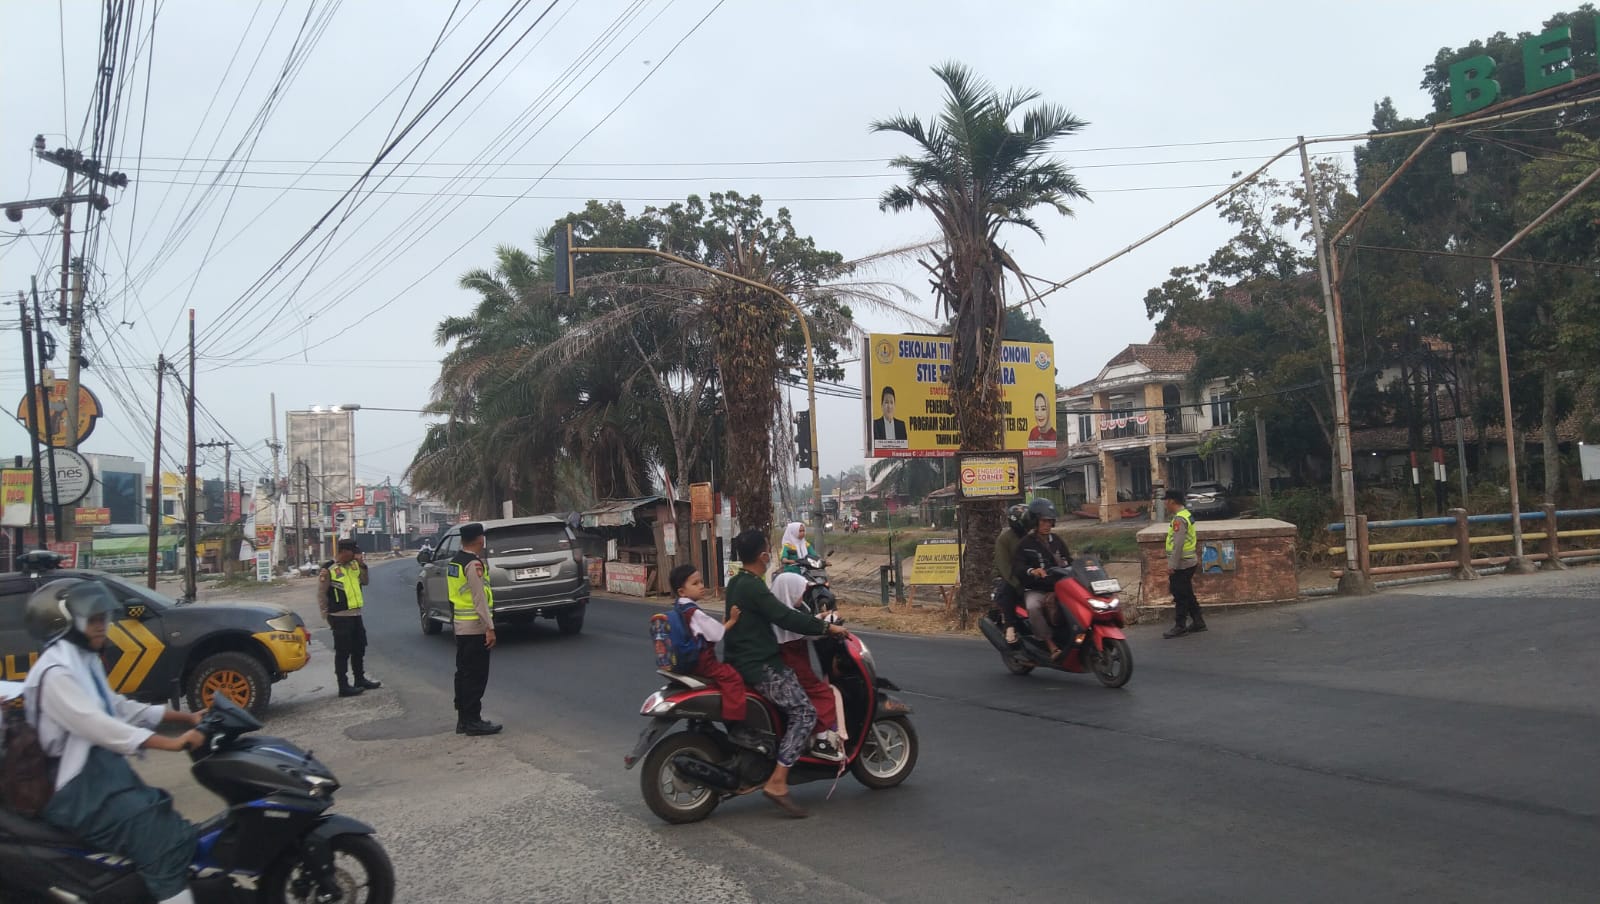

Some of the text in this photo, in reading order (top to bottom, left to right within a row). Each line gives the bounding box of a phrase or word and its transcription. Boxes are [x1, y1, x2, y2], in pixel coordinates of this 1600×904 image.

[1449, 16, 1600, 118] BE
[899, 340, 937, 359] SEKOLAH
[917, 363, 937, 382] STIE
[909, 417, 937, 431] PROGRAM
[917, 554, 933, 562] ZONA
